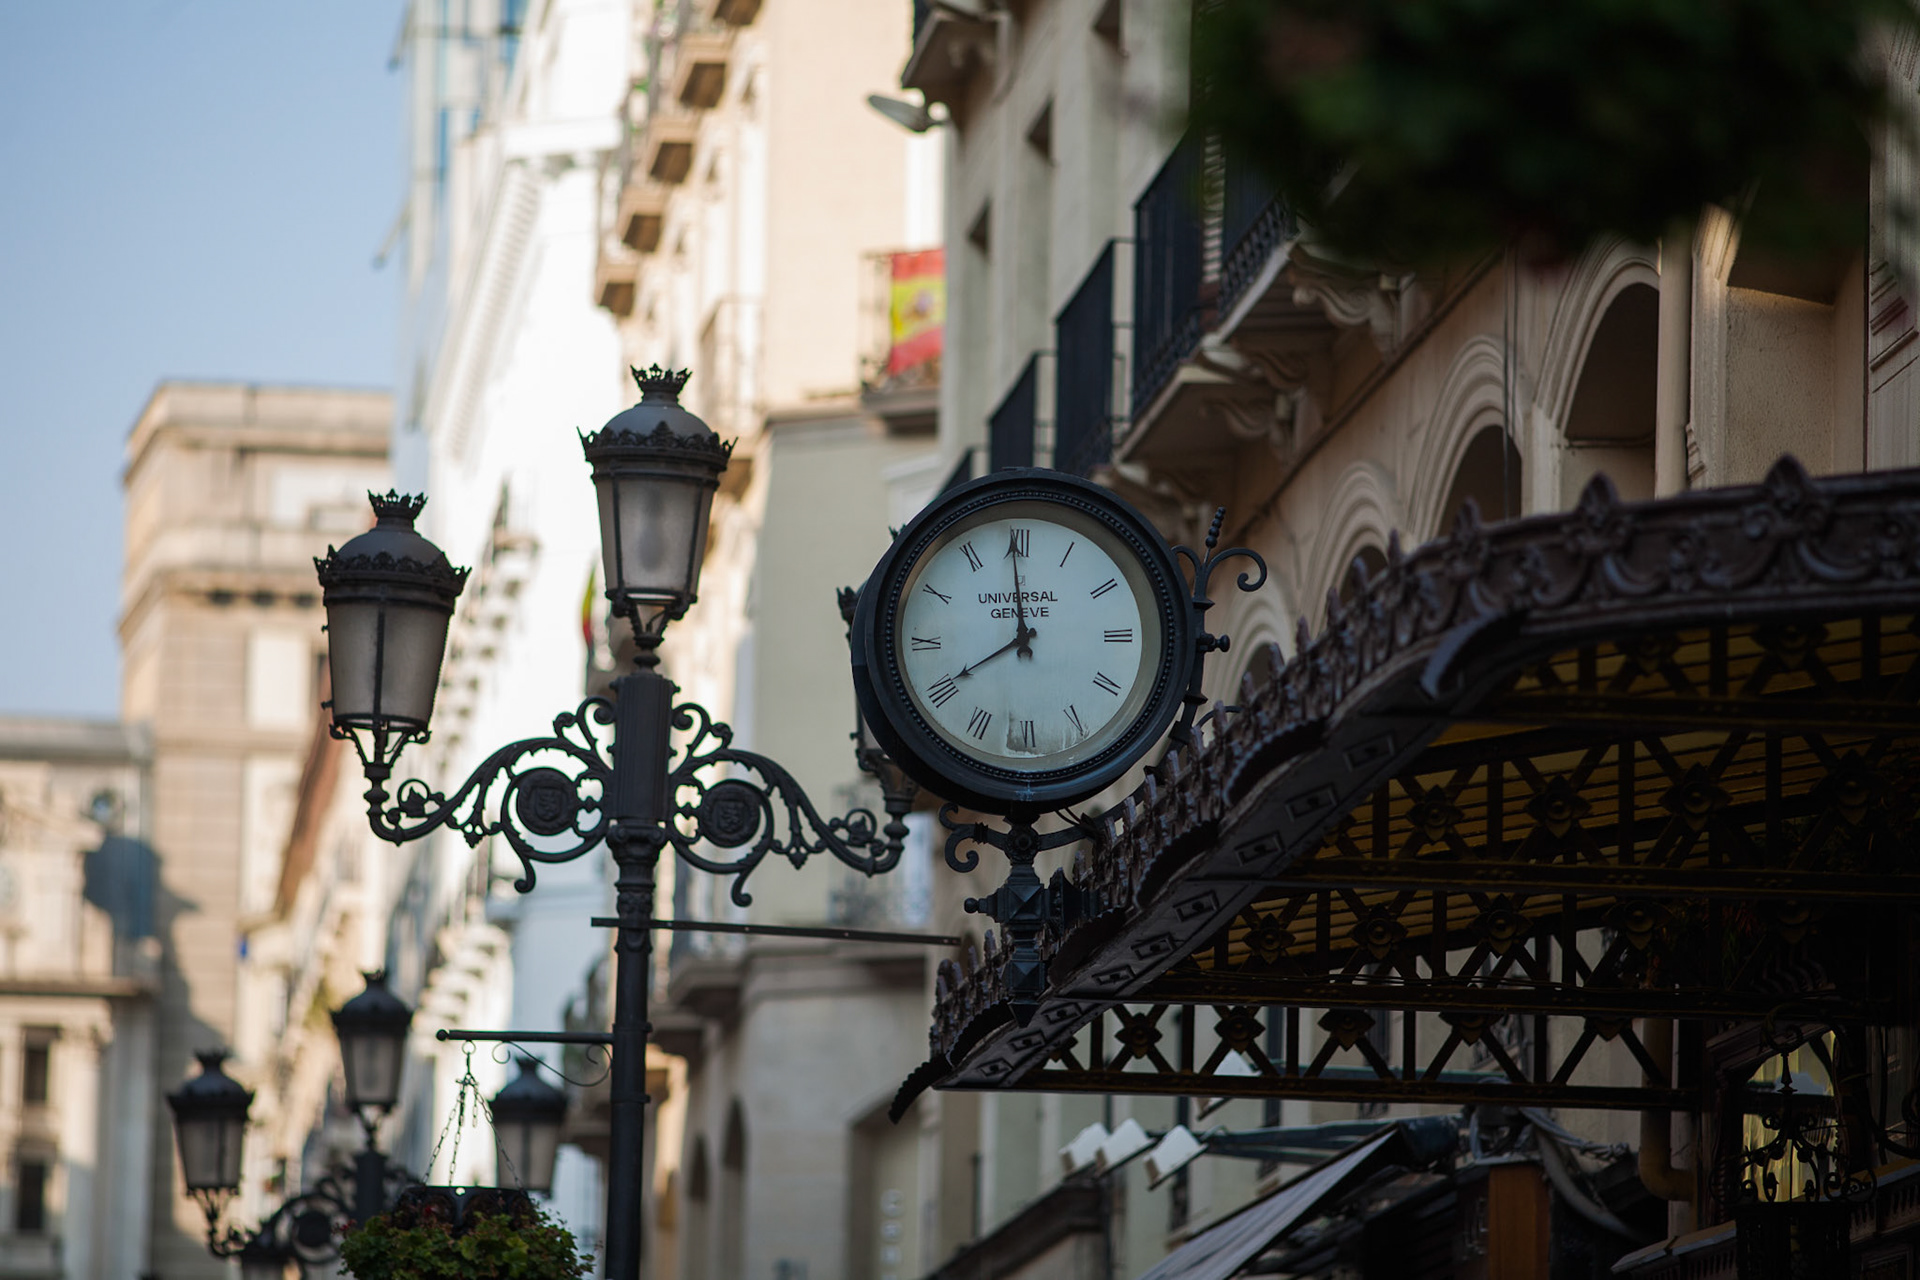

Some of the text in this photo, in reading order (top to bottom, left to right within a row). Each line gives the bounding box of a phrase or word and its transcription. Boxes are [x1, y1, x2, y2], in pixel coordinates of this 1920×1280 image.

[959, 541, 983, 572] XI
[1010, 530, 1030, 557] XII
[1059, 541, 1075, 568] I
[922, 584, 952, 605] X
[978, 591, 1058, 604] UNIVERSAL
[1090, 578, 1118, 599] II
[990, 606, 1050, 619] GENEVE
[911, 636, 941, 651] IX
[1104, 628, 1133, 643] III
[927, 673, 959, 708] VIII
[1092, 671, 1121, 696] IV
[966, 706, 992, 740] VII
[1063, 704, 1084, 736] V
[1020, 720, 1036, 748] VI
